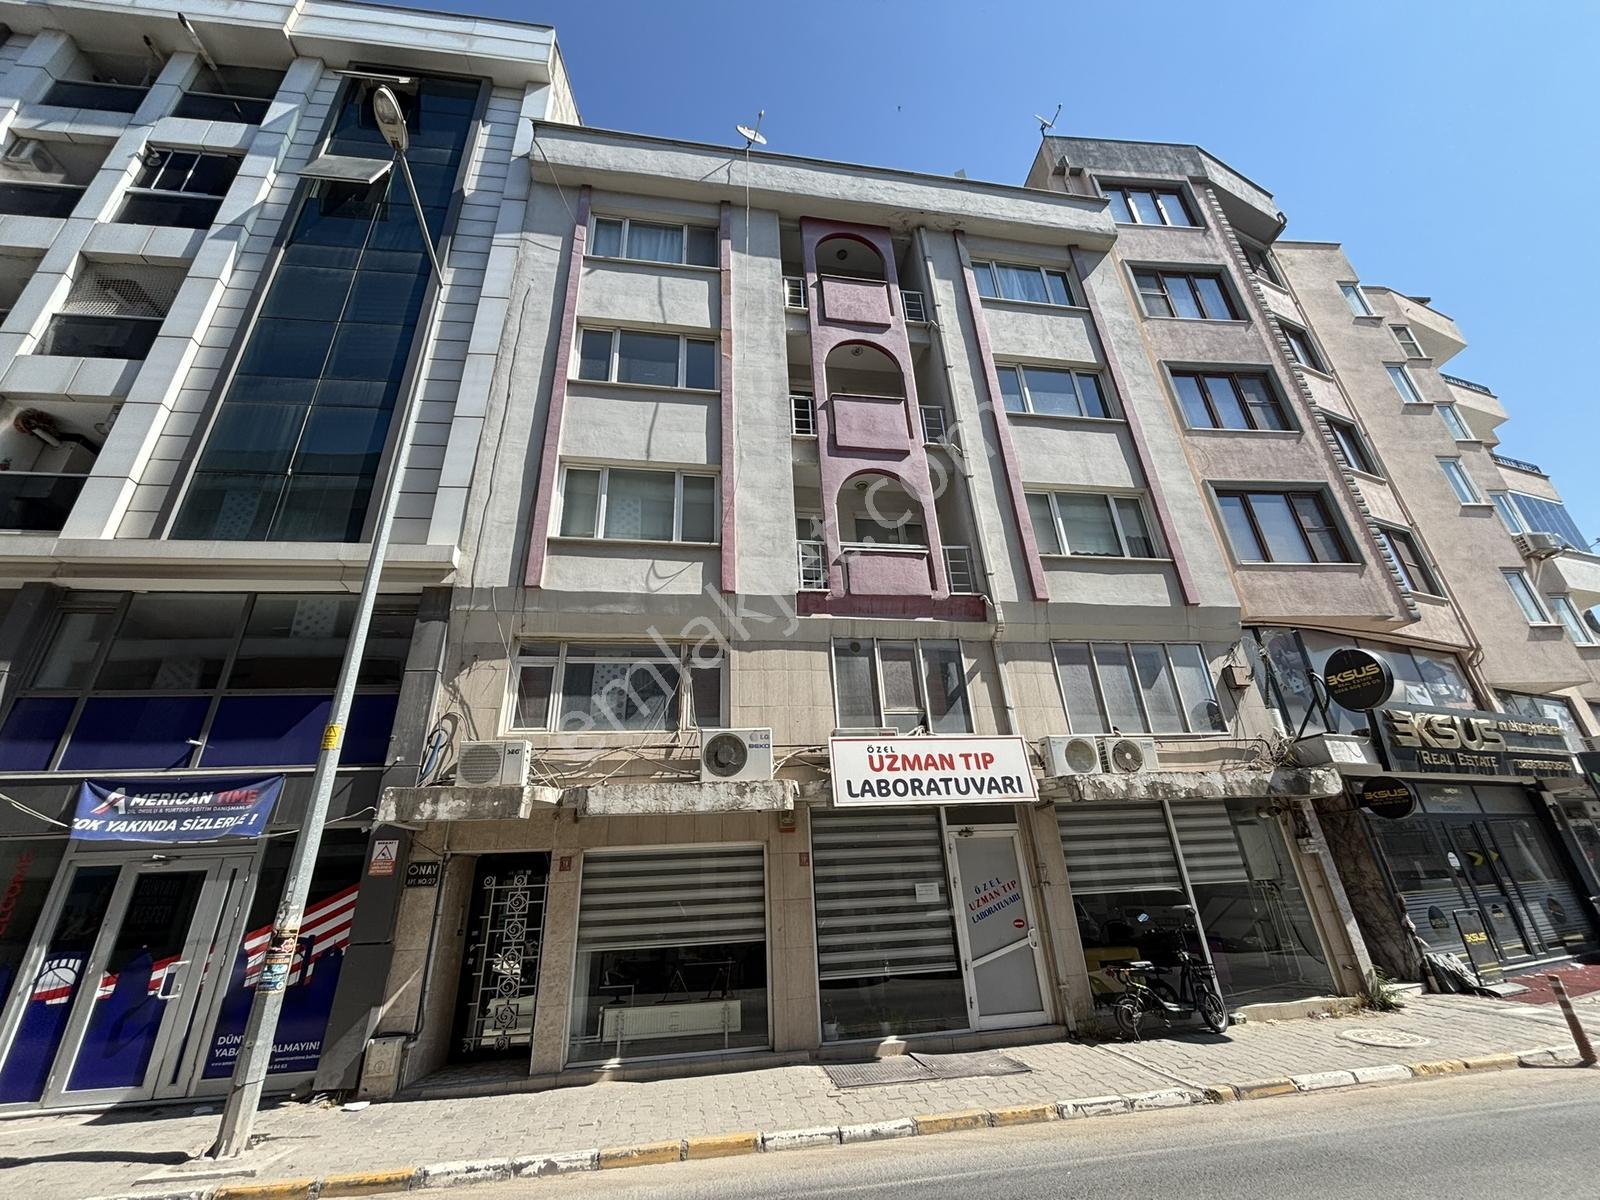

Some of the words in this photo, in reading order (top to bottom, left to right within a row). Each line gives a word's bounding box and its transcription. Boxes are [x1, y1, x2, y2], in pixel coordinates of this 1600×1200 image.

[866, 745, 895, 754] ÖZEL
[868, 753, 955, 772] UZMAN
[959, 752, 995, 770] TIP
[1422, 751, 1454, 765] REAL
[1457, 752, 1499, 768] ESTATE
[846, 775, 1024, 798] LABORATUVARI
[216, 789, 258, 804] TIME
[104, 818, 176, 832] YAKINDA
[179, 813, 249, 831] SİZLERLE
[968, 889, 1001, 911] UZMAN
[1001, 879, 1017, 893] TIP
[974, 877, 1002, 895] ÖZEL
[971, 892, 1021, 924] LABORATUVARI
[271, 1041, 320, 1053] ALMAYIN!
